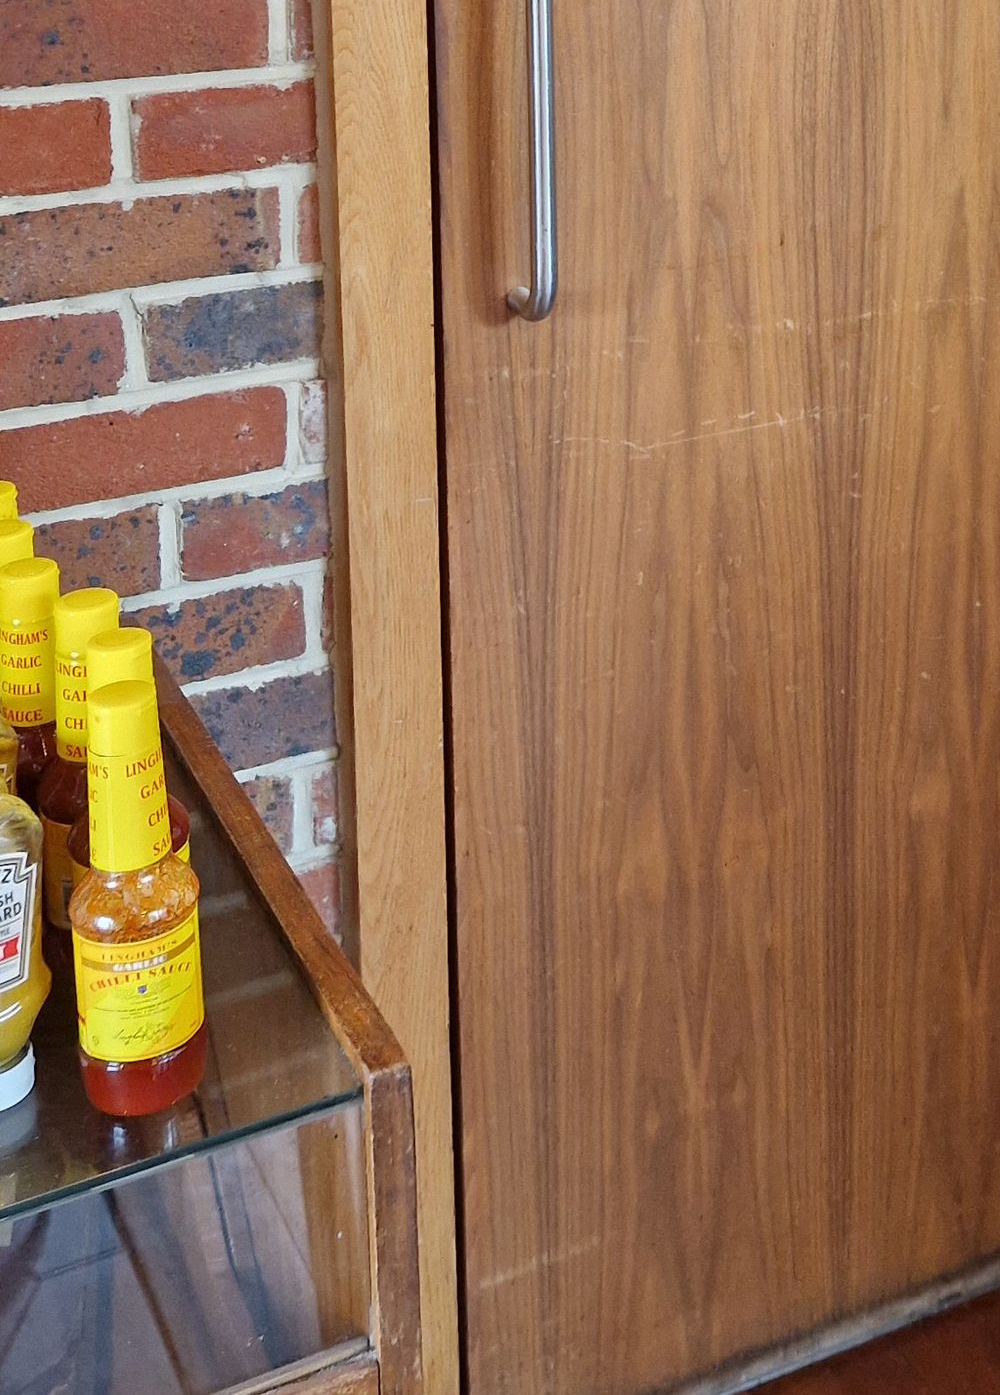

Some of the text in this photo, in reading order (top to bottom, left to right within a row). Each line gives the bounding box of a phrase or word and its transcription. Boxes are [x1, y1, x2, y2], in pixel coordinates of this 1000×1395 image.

[0, 628, 48, 645] NGHAM'S
[1, 654, 42, 669] GARLIC
[1, 680, 41, 696] CHILLI
[2, 707, 43, 722] SAUCE
